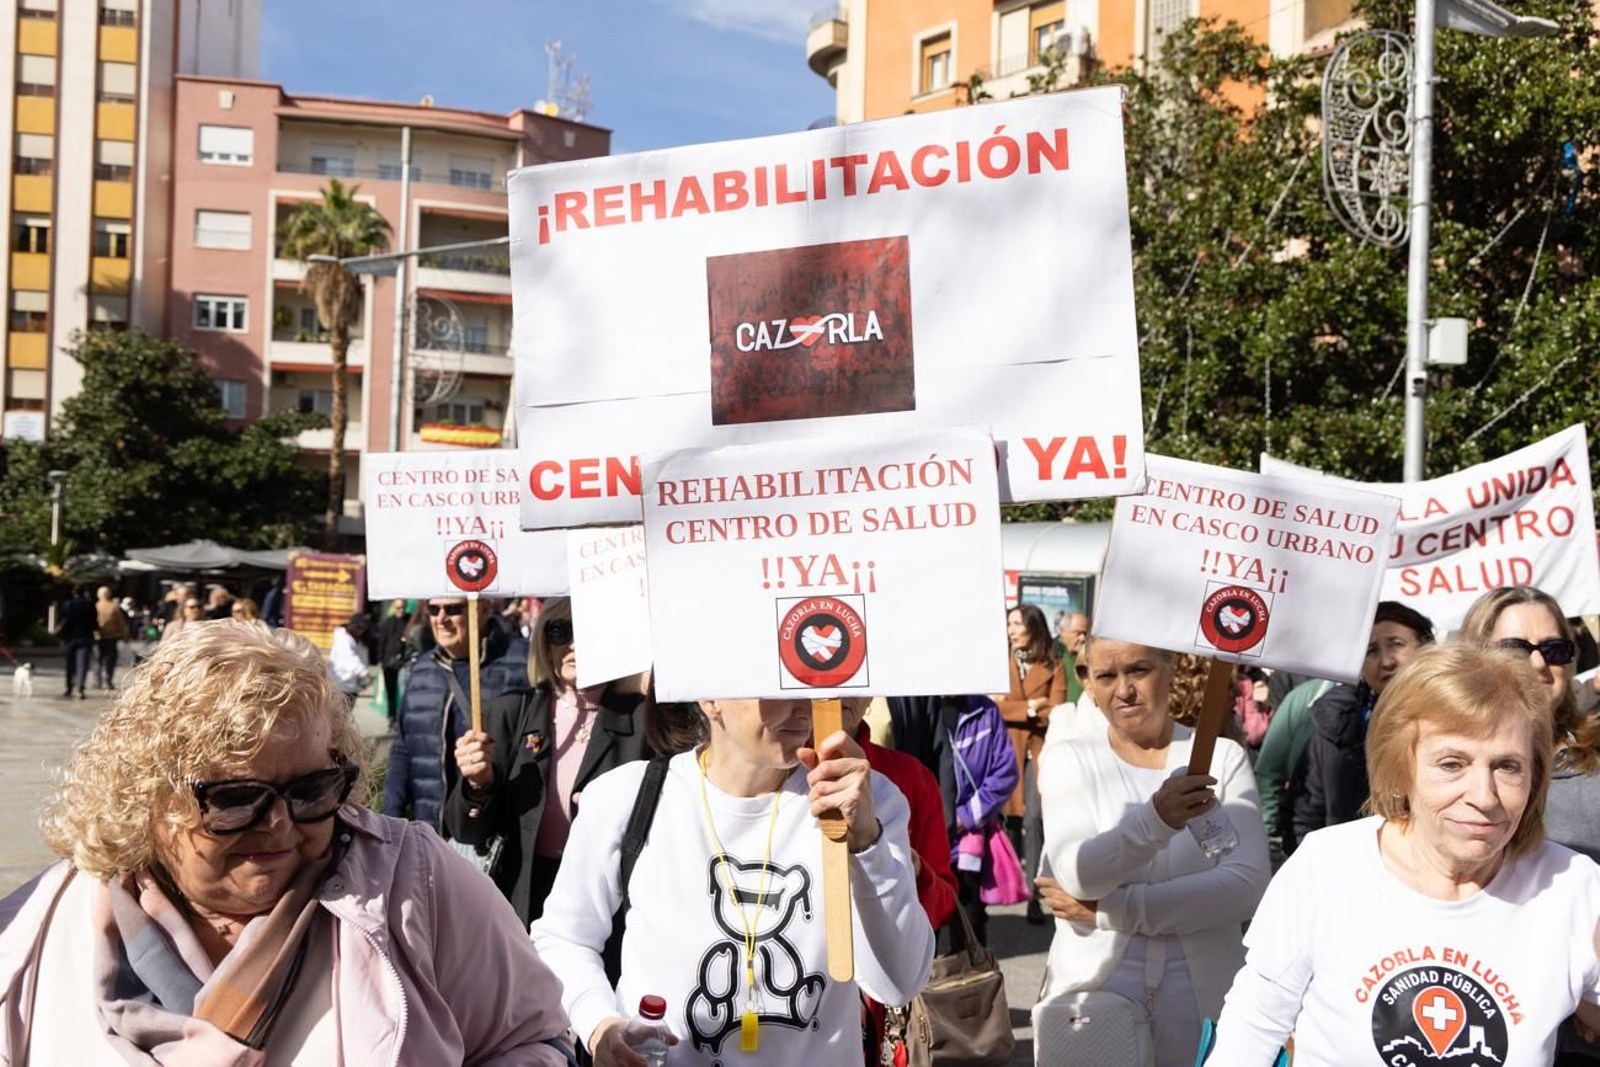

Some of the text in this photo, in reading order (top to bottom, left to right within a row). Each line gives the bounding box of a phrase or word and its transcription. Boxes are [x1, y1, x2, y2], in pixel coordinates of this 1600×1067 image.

[538, 125, 1070, 245] ¡REHABILITACIÓN
[378, 468, 520, 486] CENTRO DE SA
[657, 453, 974, 507] REHABILITACIÓN
[1023, 435, 1127, 481] YA!
[377, 493, 401, 509] EN
[408, 492, 474, 508] CASCO
[1467, 456, 1577, 510] UNIDA
[666, 501, 977, 545] CENTRO DE SALUD
[1130, 504, 1375, 564] EN CASCO URBANO
[1251, 497, 1287, 519] DE
[1293, 504, 1379, 535] SALUD
[1416, 506, 1575, 557] CENTRO
[1400, 556, 1533, 597] SALUD
[783, 601, 861, 640] CAZORLA EN LUCHA
[1206, 590, 1238, 612] CAZORLA
[1239, 590, 1251, 599] EN
[1355, 945, 1525, 1026] CAZORLA EN LUCHA
[1382, 970, 1497, 1020] SANIDAD PÚBLICA
